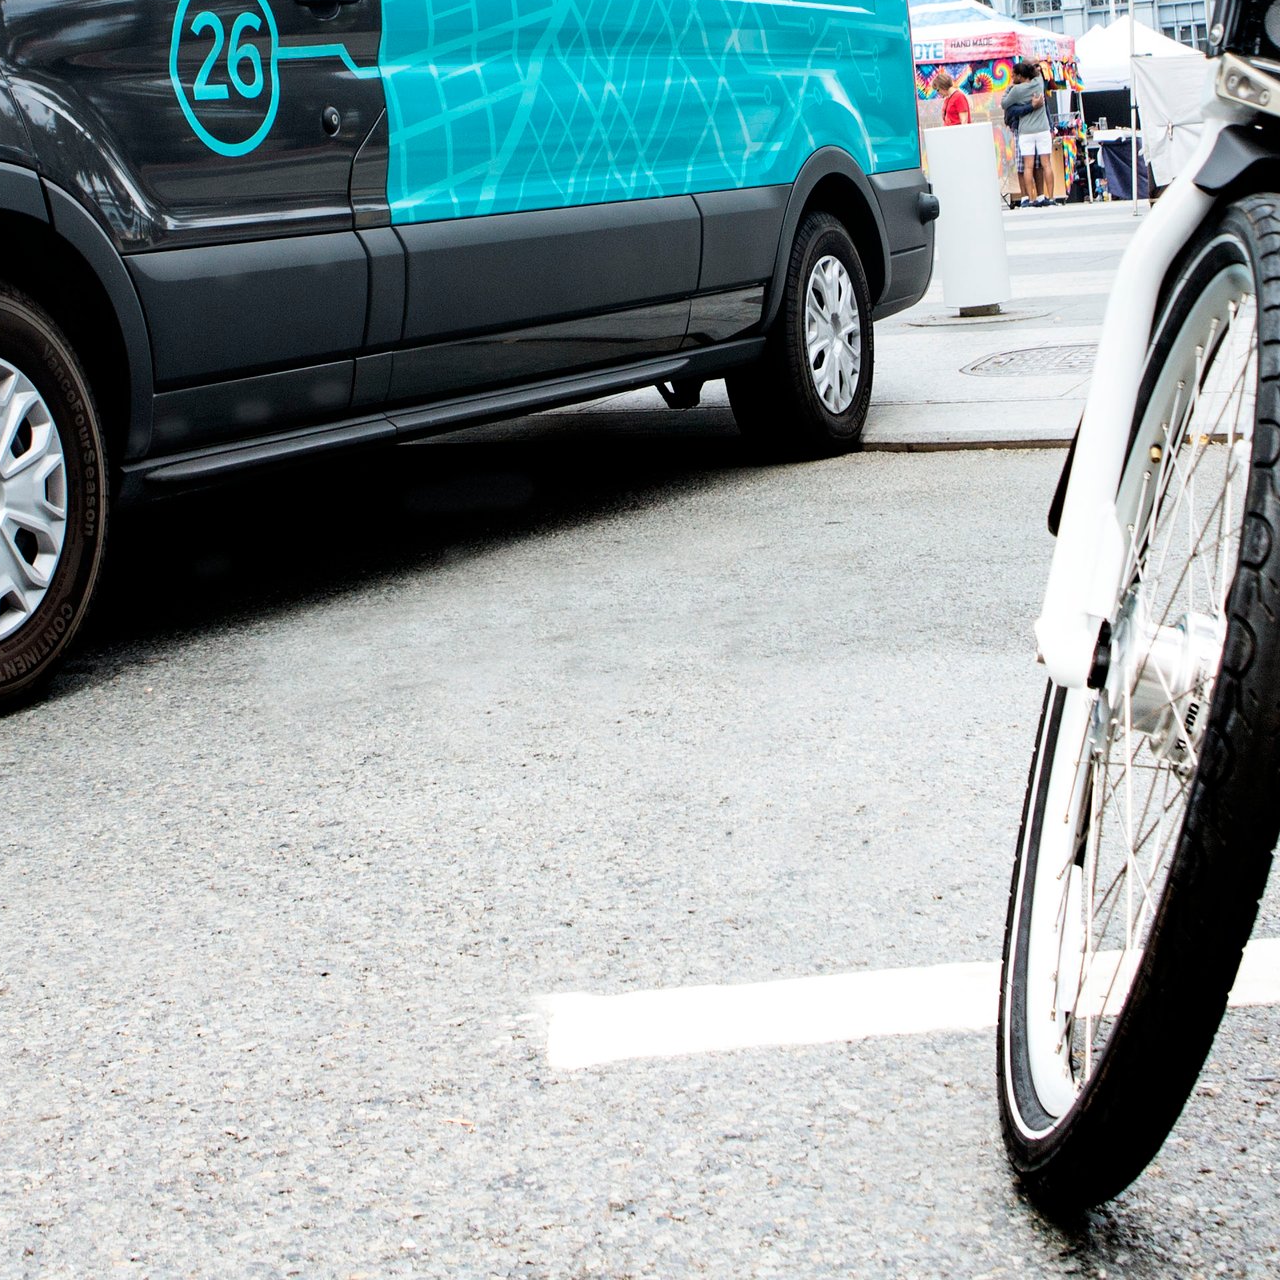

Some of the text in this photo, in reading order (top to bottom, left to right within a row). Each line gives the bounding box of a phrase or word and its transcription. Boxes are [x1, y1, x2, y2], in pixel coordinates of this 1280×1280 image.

[191, 10, 264, 101] 26
[950, 39, 971, 49] HAND
[971, 37, 994, 47] MADE
